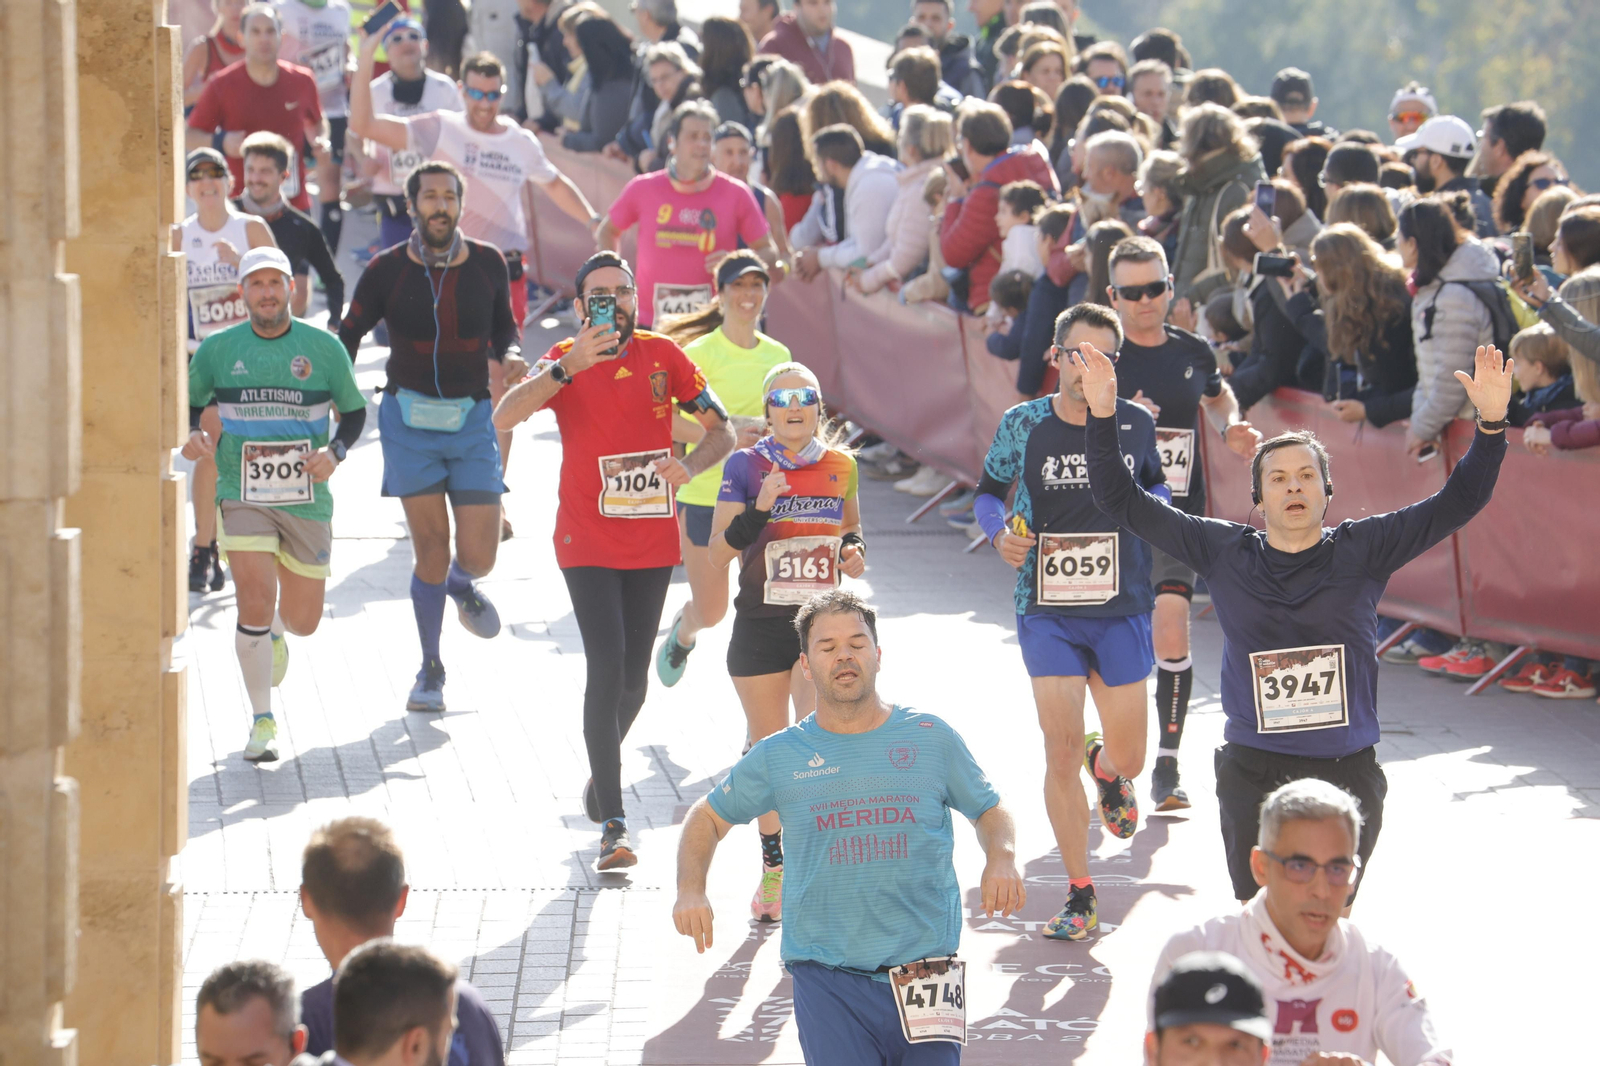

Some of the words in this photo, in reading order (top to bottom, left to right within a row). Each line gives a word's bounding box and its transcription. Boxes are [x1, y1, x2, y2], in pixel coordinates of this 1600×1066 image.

[656, 203, 673, 224] 9
[199, 299, 247, 323] 5098
[240, 388, 303, 404] ATLETISMO
[233, 405, 310, 418] TORREMOLINOS
[250, 462, 305, 480] 3909
[615, 472, 660, 492] 1104
[779, 557, 830, 580] 5163
[1045, 555, 1111, 577] 6059
[1264, 670, 1336, 701] 3947
[793, 766, 840, 780] Santander
[809, 802, 828, 813] XVII
[830, 797, 866, 809] MEDIA
[868, 794, 920, 804] MARATÓN
[816, 806, 917, 832] MÉRIDA
[905, 983, 963, 1010] 4748
